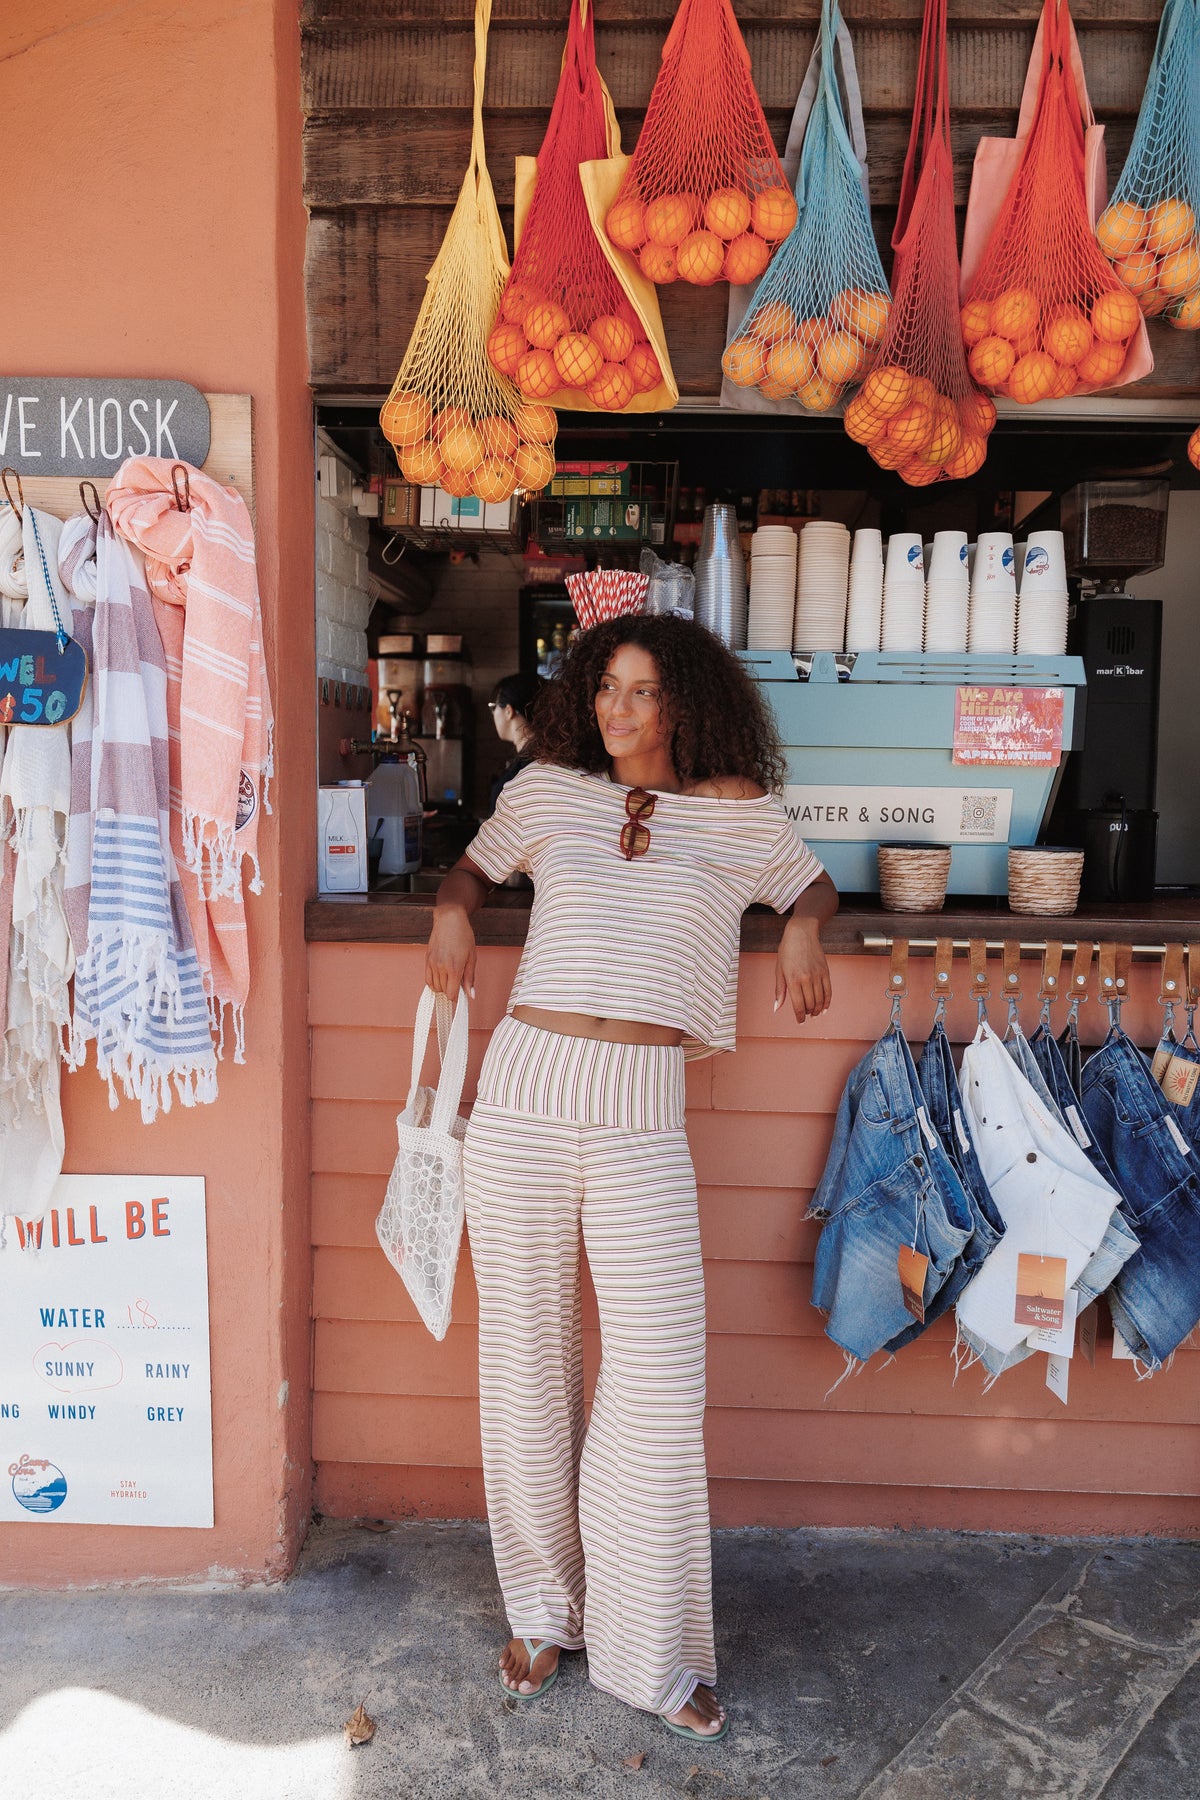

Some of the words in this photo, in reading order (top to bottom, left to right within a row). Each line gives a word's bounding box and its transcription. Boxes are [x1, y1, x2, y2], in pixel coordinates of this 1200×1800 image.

[60, 396, 180, 460] KIOSK
[0, 654, 56, 686] WEL
[960, 688, 988, 702] We
[992, 688, 1024, 703] Are
[0, 688, 67, 725] $50
[960, 702, 1018, 718] Hiring
[1006, 751, 1052, 760] WITHIN
[784, 806, 849, 822] WATER
[859, 807, 870, 822] &
[880, 807, 935, 823] SONG
[14, 1204, 107, 1251] WILL
[125, 1197, 170, 1240] BE
[40, 1308, 105, 1328] WATER
[127, 1298, 158, 1328] 18
[1026, 1304, 1061, 1316] Saltwater
[1041, 1315, 1060, 1324] Song
[45, 1362, 94, 1377] SUNNY
[145, 1363, 190, 1378] RAINY
[48, 1405, 96, 1419] WINDY
[147, 1407, 184, 1422] GREY
